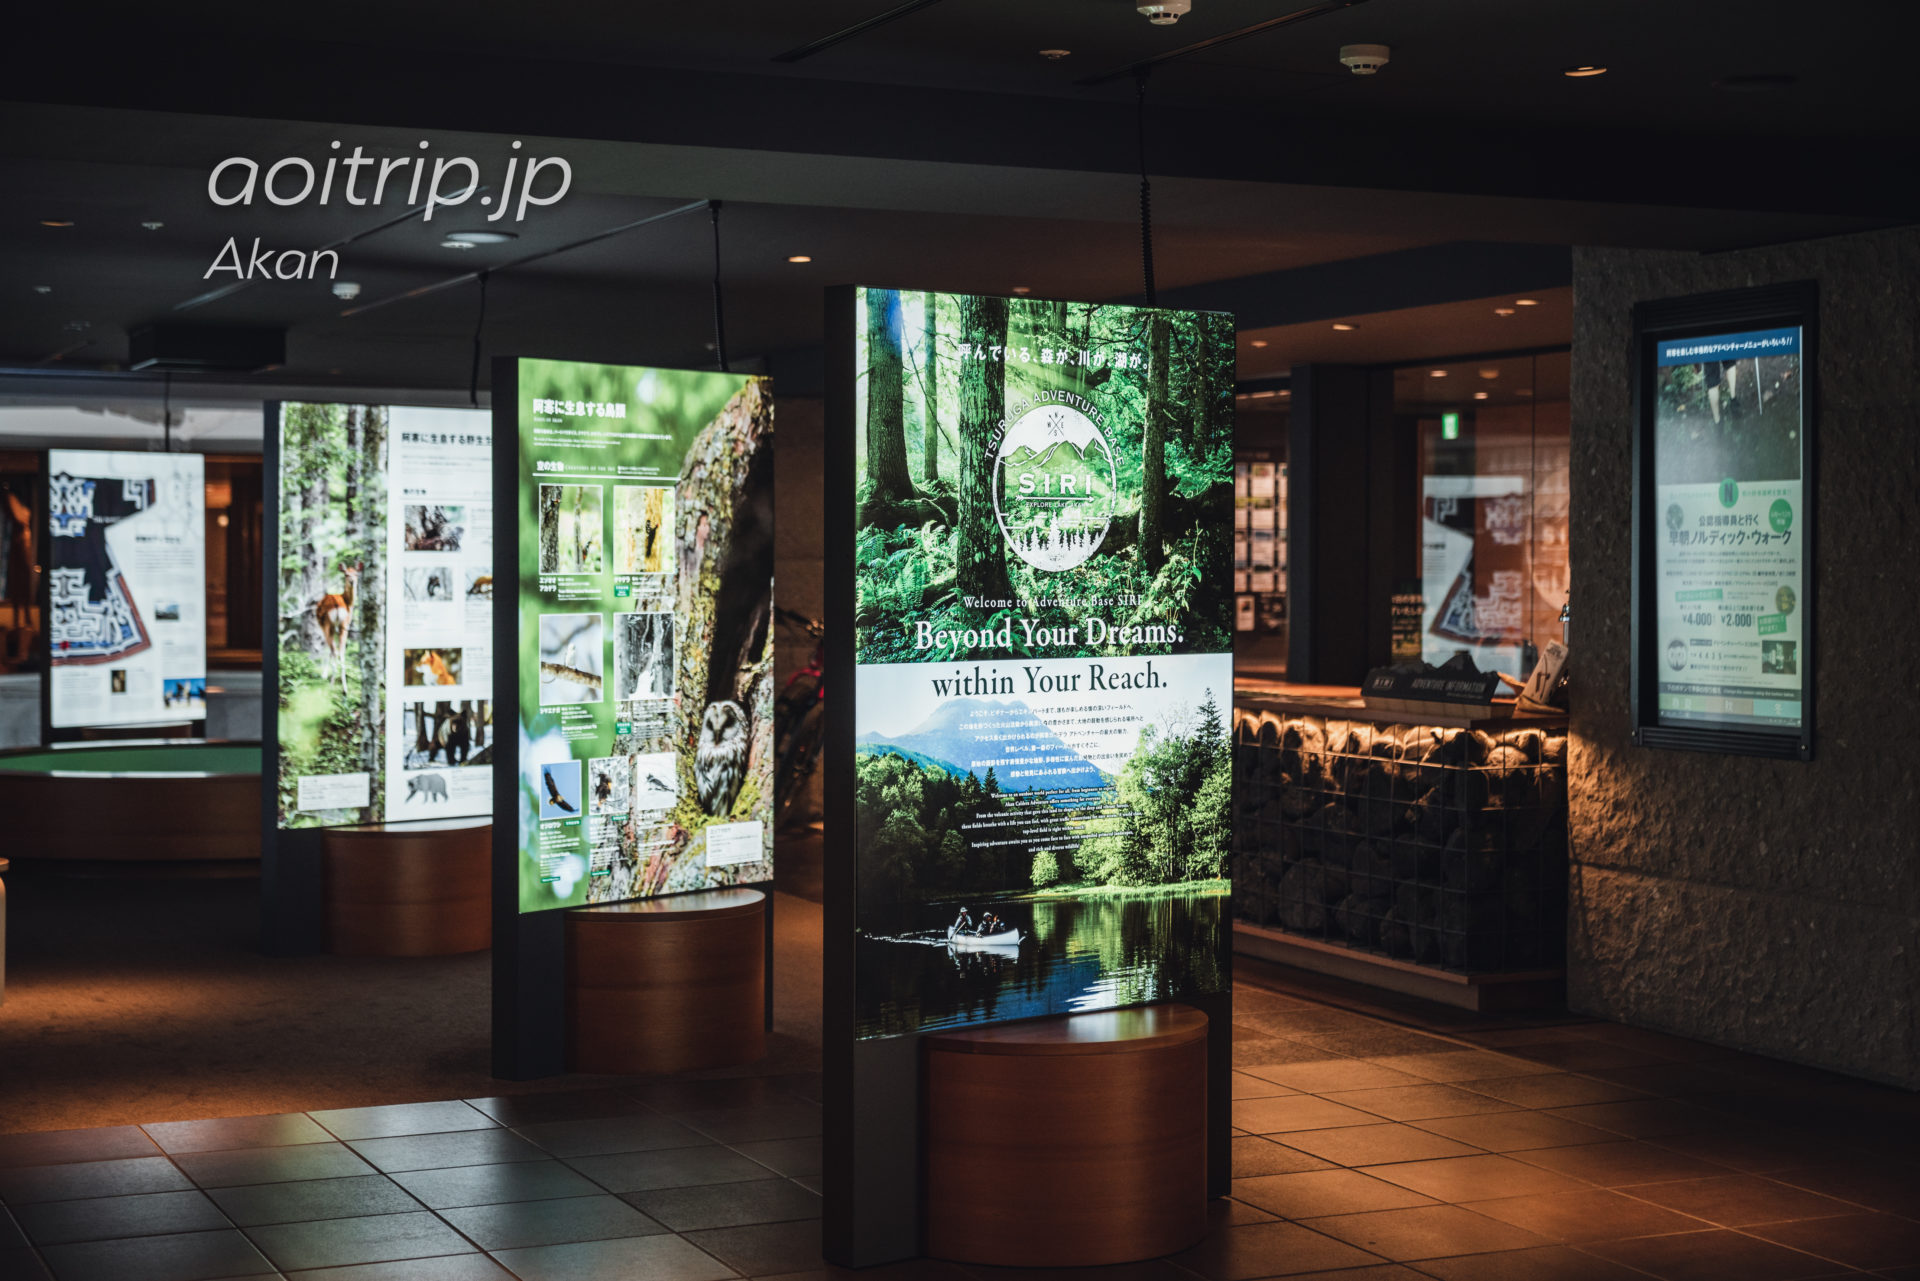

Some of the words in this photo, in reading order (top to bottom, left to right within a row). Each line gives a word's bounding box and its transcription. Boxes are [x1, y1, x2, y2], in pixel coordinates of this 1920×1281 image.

[958, 343, 1148, 370] 呼んでいる、森が、川が、湖が。
[984, 399, 1030, 459] TSURUGA
[1034, 390, 1105, 426] ADVENTURE
[1104, 426, 1124, 468] BASE
[1018, 473, 1091, 495] SIRI
[963, 596, 1012, 608] Welcome
[1016, 597, 1027, 608] to
[1033, 596, 1088, 608] Adventure
[1091, 595, 1114, 607] Base
[1117, 594, 1143, 607] SIRI
[914, 617, 1012, 659] Beyond
[1019, 618, 1078, 648] Your
[1085, 616, 1185, 645] Dreams.
[932, 664, 1015, 697] within
[1022, 666, 1081, 694] Your
[1088, 660, 1168, 691] Reach.
[971, 841, 989, 849] Inspiring
